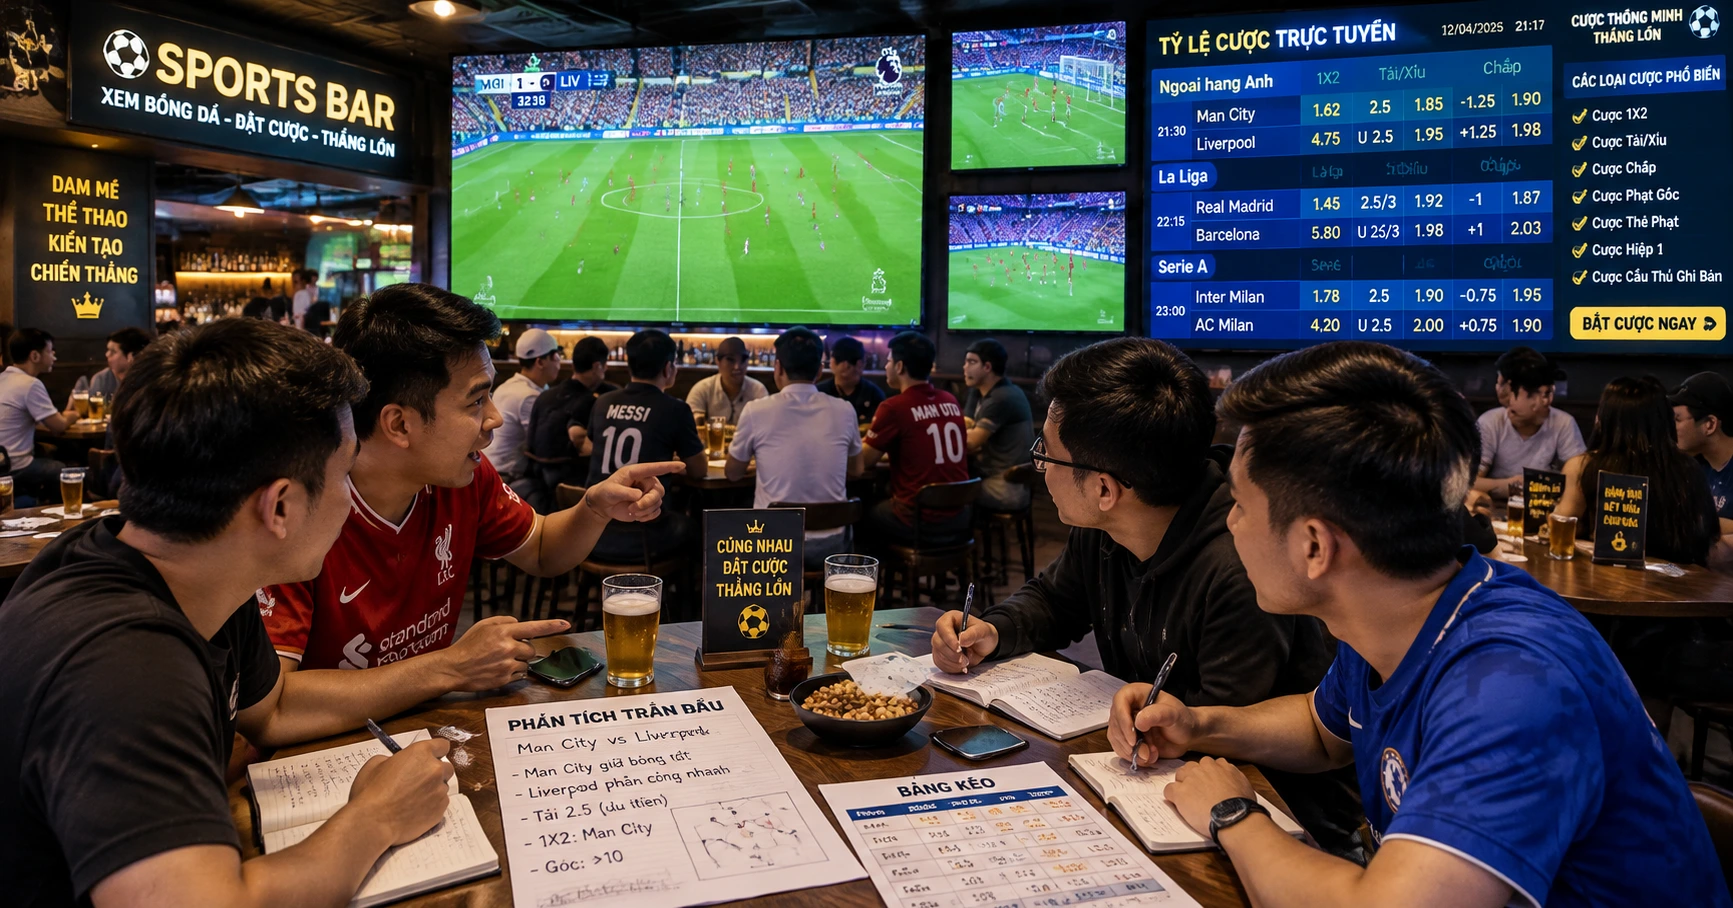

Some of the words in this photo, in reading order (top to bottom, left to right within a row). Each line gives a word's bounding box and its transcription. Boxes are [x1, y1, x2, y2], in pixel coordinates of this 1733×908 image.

[1651, 9, 1684, 23] MINH
[1188, 30, 1210, 56] LỆ
[1215, 29, 1270, 54] CƯỢC
[1276, 25, 1328, 52] TRỰC
[1515, 20, 1546, 32] 21:17
[156, 42, 318, 114] SPORTS
[326, 82, 396, 132] BAR
[561, 75, 580, 88] LIV
[1245, 74, 1274, 90] Anh
[1317, 71, 1340, 84] 1X2
[1600, 73, 1626, 89] LOẠI
[101, 86, 140, 111] XEM
[268, 119, 310, 144] CƯỢC
[1197, 109, 1226, 124] Man
[1229, 107, 1256, 124] City
[1313, 103, 1341, 118] 1.62
[1370, 100, 1391, 114] 2.5
[1414, 97, 1444, 112] 1.85
[1460, 94, 1496, 110] -1.25
[1512, 92, 1542, 107] 1.90
[1592, 109, 1623, 124] Cược
[1626, 106, 1648, 120] 1X2
[1158, 126, 1187, 138] 21:30
[1197, 136, 1256, 152] Liverpool
[1311, 132, 1341, 146] 4.75
[1358, 130, 1368, 144] U
[1372, 130, 1394, 144] 2.5
[1414, 127, 1444, 142] 1.95
[1460, 124, 1497, 140] +1.25
[1512, 122, 1542, 138] 1.98
[1592, 136, 1623, 151] Cược
[1158, 170, 1176, 184] La
[1180, 168, 1208, 186] Liga
[1592, 163, 1623, 178] Cược
[52, 174, 91, 196] DAM
[1196, 200, 1225, 214] Real
[1229, 199, 1274, 214] Madrid
[1313, 196, 1341, 211] 1.45
[1360, 194, 1397, 211] 2.5/3
[1414, 194, 1444, 208] 1.92
[1468, 192, 1482, 206] -1
[1512, 190, 1542, 206] 1.87
[1592, 190, 1623, 205] Cược
[1626, 188, 1654, 204] Phạt
[1656, 187, 1680, 202] Góc
[82, 206, 128, 228] THAO
[1156, 216, 1186, 228] 22:15
[1592, 217, 1623, 232] Cược
[1652, 215, 1680, 231] Phạt
[1196, 228, 1260, 242] Barcelona
[1311, 226, 1341, 240] 5.80
[1358, 226, 1367, 239] U
[1414, 224, 1444, 238] 1.98
[1468, 222, 1483, 237] +1
[1510, 220, 1542, 236] 2.03
[91, 236, 124, 260] TẠO
[1592, 244, 1623, 259] Cược
[1626, 242, 1654, 258] Hiệp
[1656, 243, 1664, 256] 1
[1158, 259, 1194, 274] Serie
[1197, 259, 1208, 274] A
[1592, 270, 1623, 286] Cược
[1676, 270, 1696, 283] Ghi
[1196, 290, 1226, 304] Inter
[1230, 290, 1265, 304] Milan
[1312, 290, 1340, 304] 1.78
[1369, 288, 1390, 303] 2.5
[1414, 288, 1444, 303] 1.90
[1460, 288, 1497, 303] -0.75
[1512, 288, 1542, 302] 1.95
[1156, 306, 1186, 317] 23:00
[1195, 318, 1215, 332] AC
[1218, 318, 1254, 332] Milan
[1358, 319, 1368, 332] U
[1372, 318, 1392, 332] 2.5
[1414, 318, 1444, 333] 2.00
[1459, 318, 1498, 333] +0.75
[1512, 318, 1542, 333] 1.90
[1614, 315, 1654, 334] CƯỢC
[1658, 317, 1698, 331] NGAY
[606, 404, 652, 422] MESSI
[601, 426, 643, 474] 10
[926, 422, 964, 465] 10
[756, 539, 793, 553] NHAU
[569, 710, 618, 726] TÍCH
[518, 743, 554, 755] Man
[562, 738, 598, 752] City
[607, 736, 628, 745] vs
[524, 767, 558, 779] Man
[564, 762, 592, 776] City
[565, 804, 592, 818] 2.5
[539, 832, 578, 848] 1X2:
[582, 828, 616, 842] Man
[621, 822, 653, 838] City
